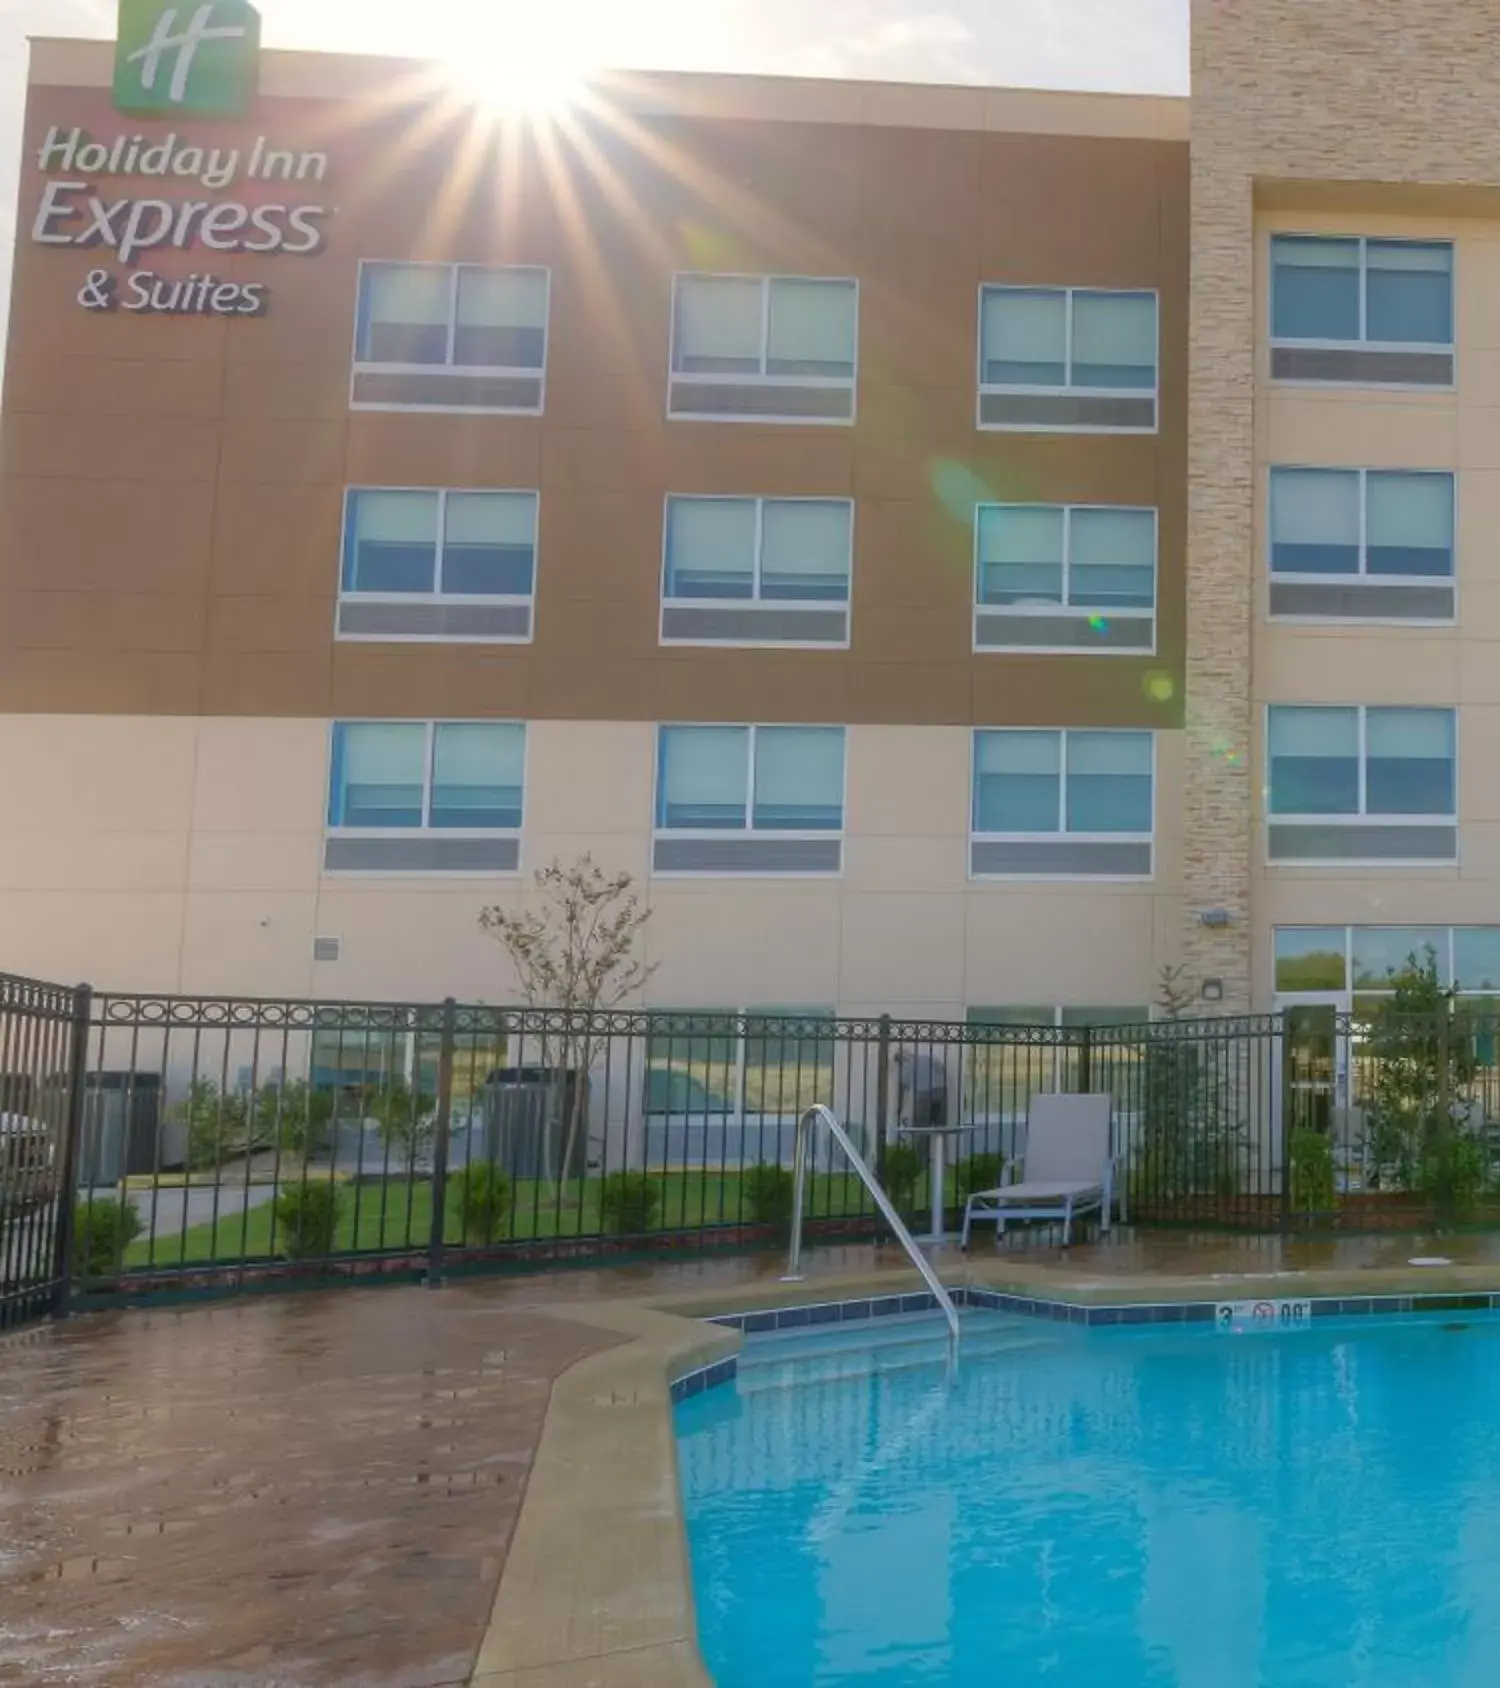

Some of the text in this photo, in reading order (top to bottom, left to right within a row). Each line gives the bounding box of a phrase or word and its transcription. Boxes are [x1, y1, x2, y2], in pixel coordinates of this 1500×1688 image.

[37, 125, 328, 188] Holiday Inn
[31, 181, 324, 264] Express
[76, 269, 263, 313] & Suites
